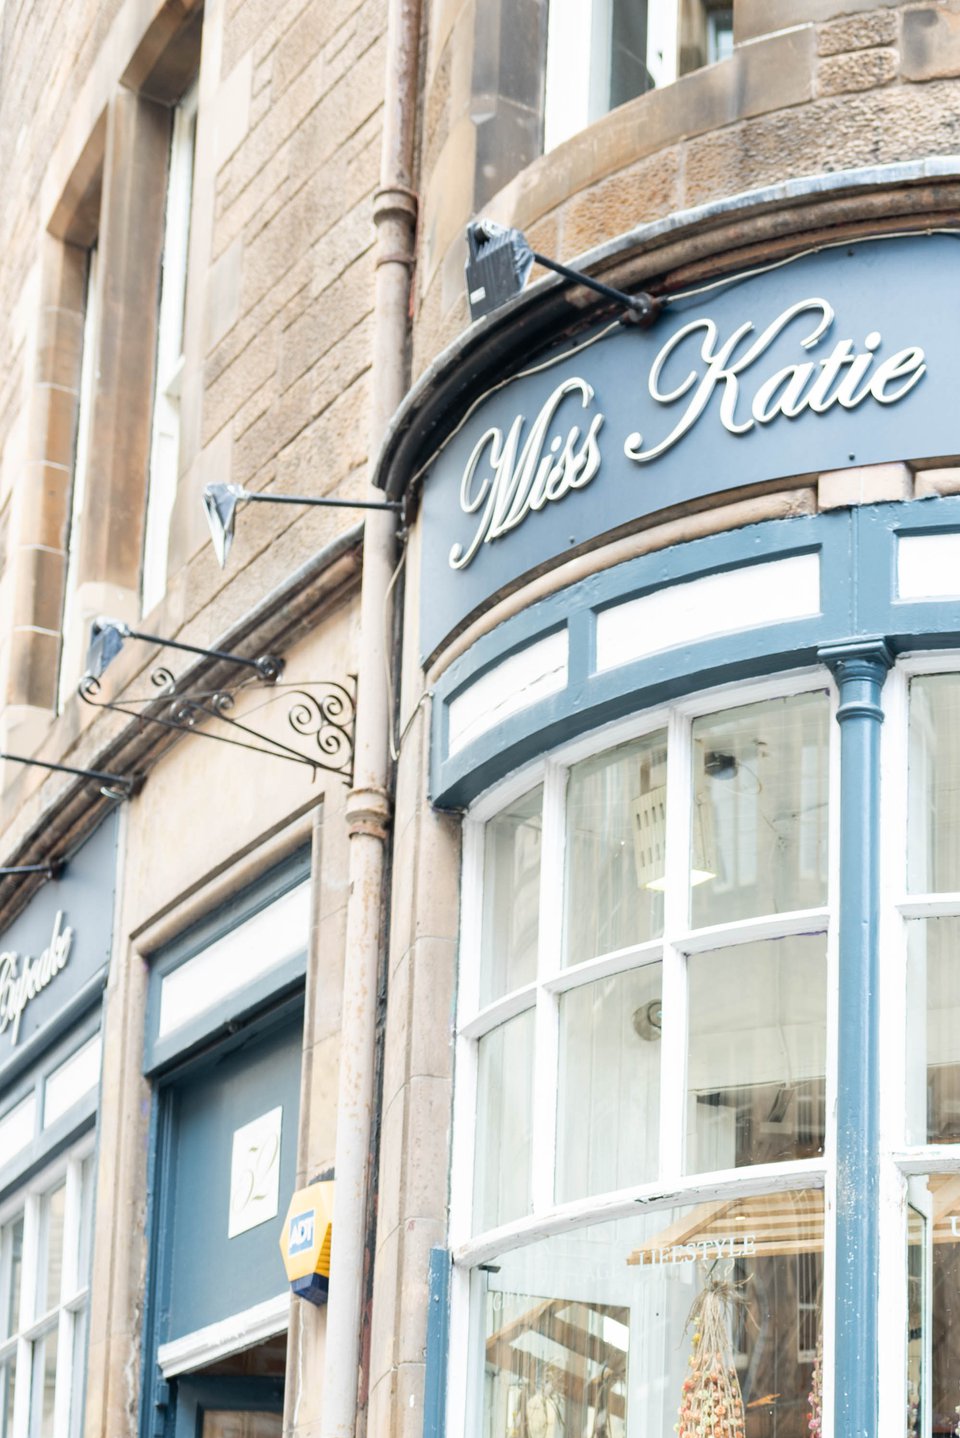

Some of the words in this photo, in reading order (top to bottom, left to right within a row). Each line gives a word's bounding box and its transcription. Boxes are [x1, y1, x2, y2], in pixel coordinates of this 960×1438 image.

[448, 376, 605, 570] Miss
[625, 296, 927, 464] Katie
[290, 1216, 314, 1249] ADT
[638, 1234, 757, 1270] LIFESTYLE
